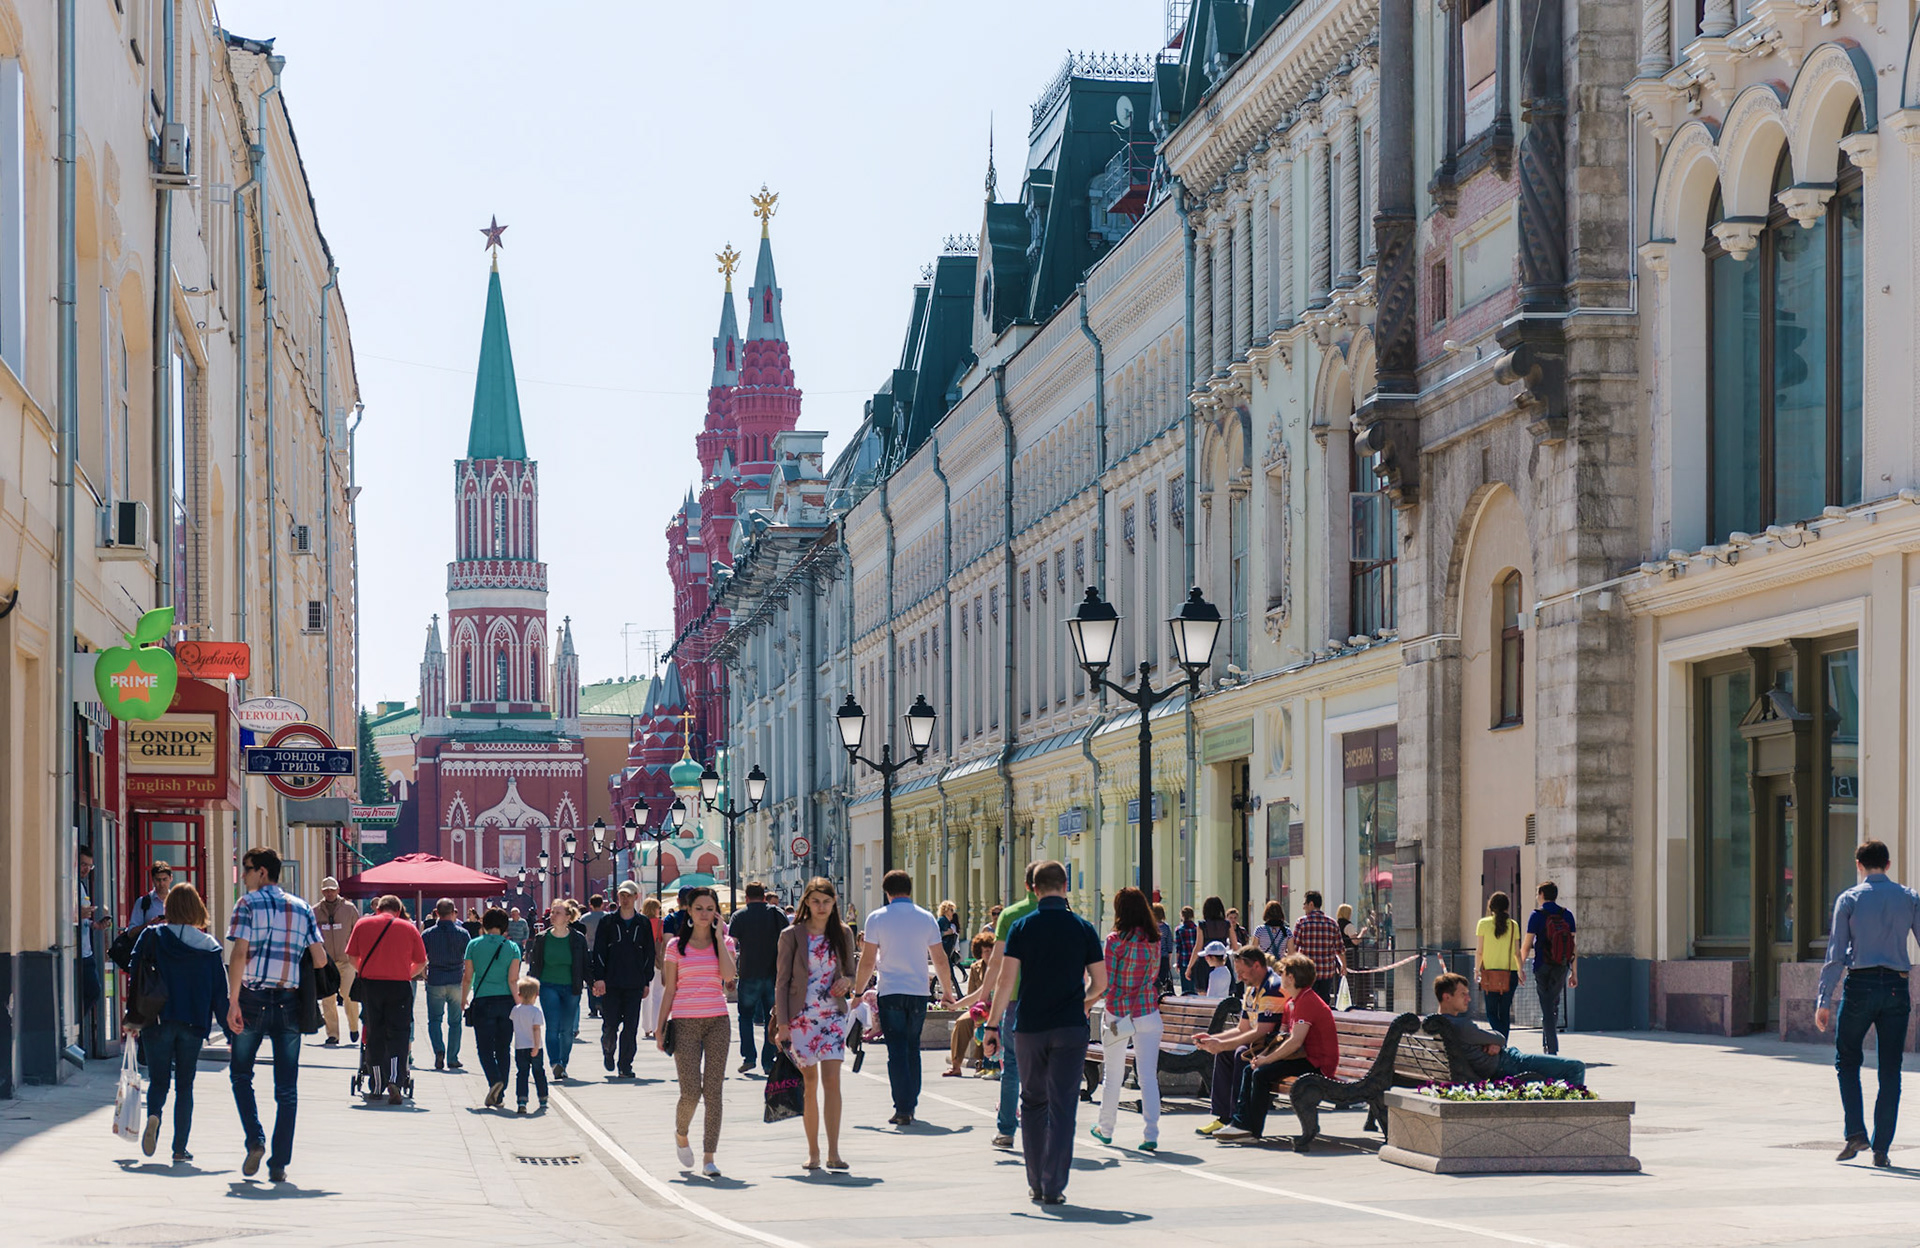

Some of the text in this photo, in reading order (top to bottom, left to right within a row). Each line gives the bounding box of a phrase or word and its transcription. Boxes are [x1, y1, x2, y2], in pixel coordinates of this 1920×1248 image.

[110, 675, 158, 688] PRIME
[239, 710, 301, 721] TERVOLINA
[129, 730, 213, 744] LONDON
[141, 744, 202, 757] GRILL
[274, 752, 326, 763] ЛОНДОН
[1345, 746, 1374, 769] ЭКОНИКА
[281, 762, 321, 772] ГРИЛЬ
[127, 779, 216, 794] English Pub
